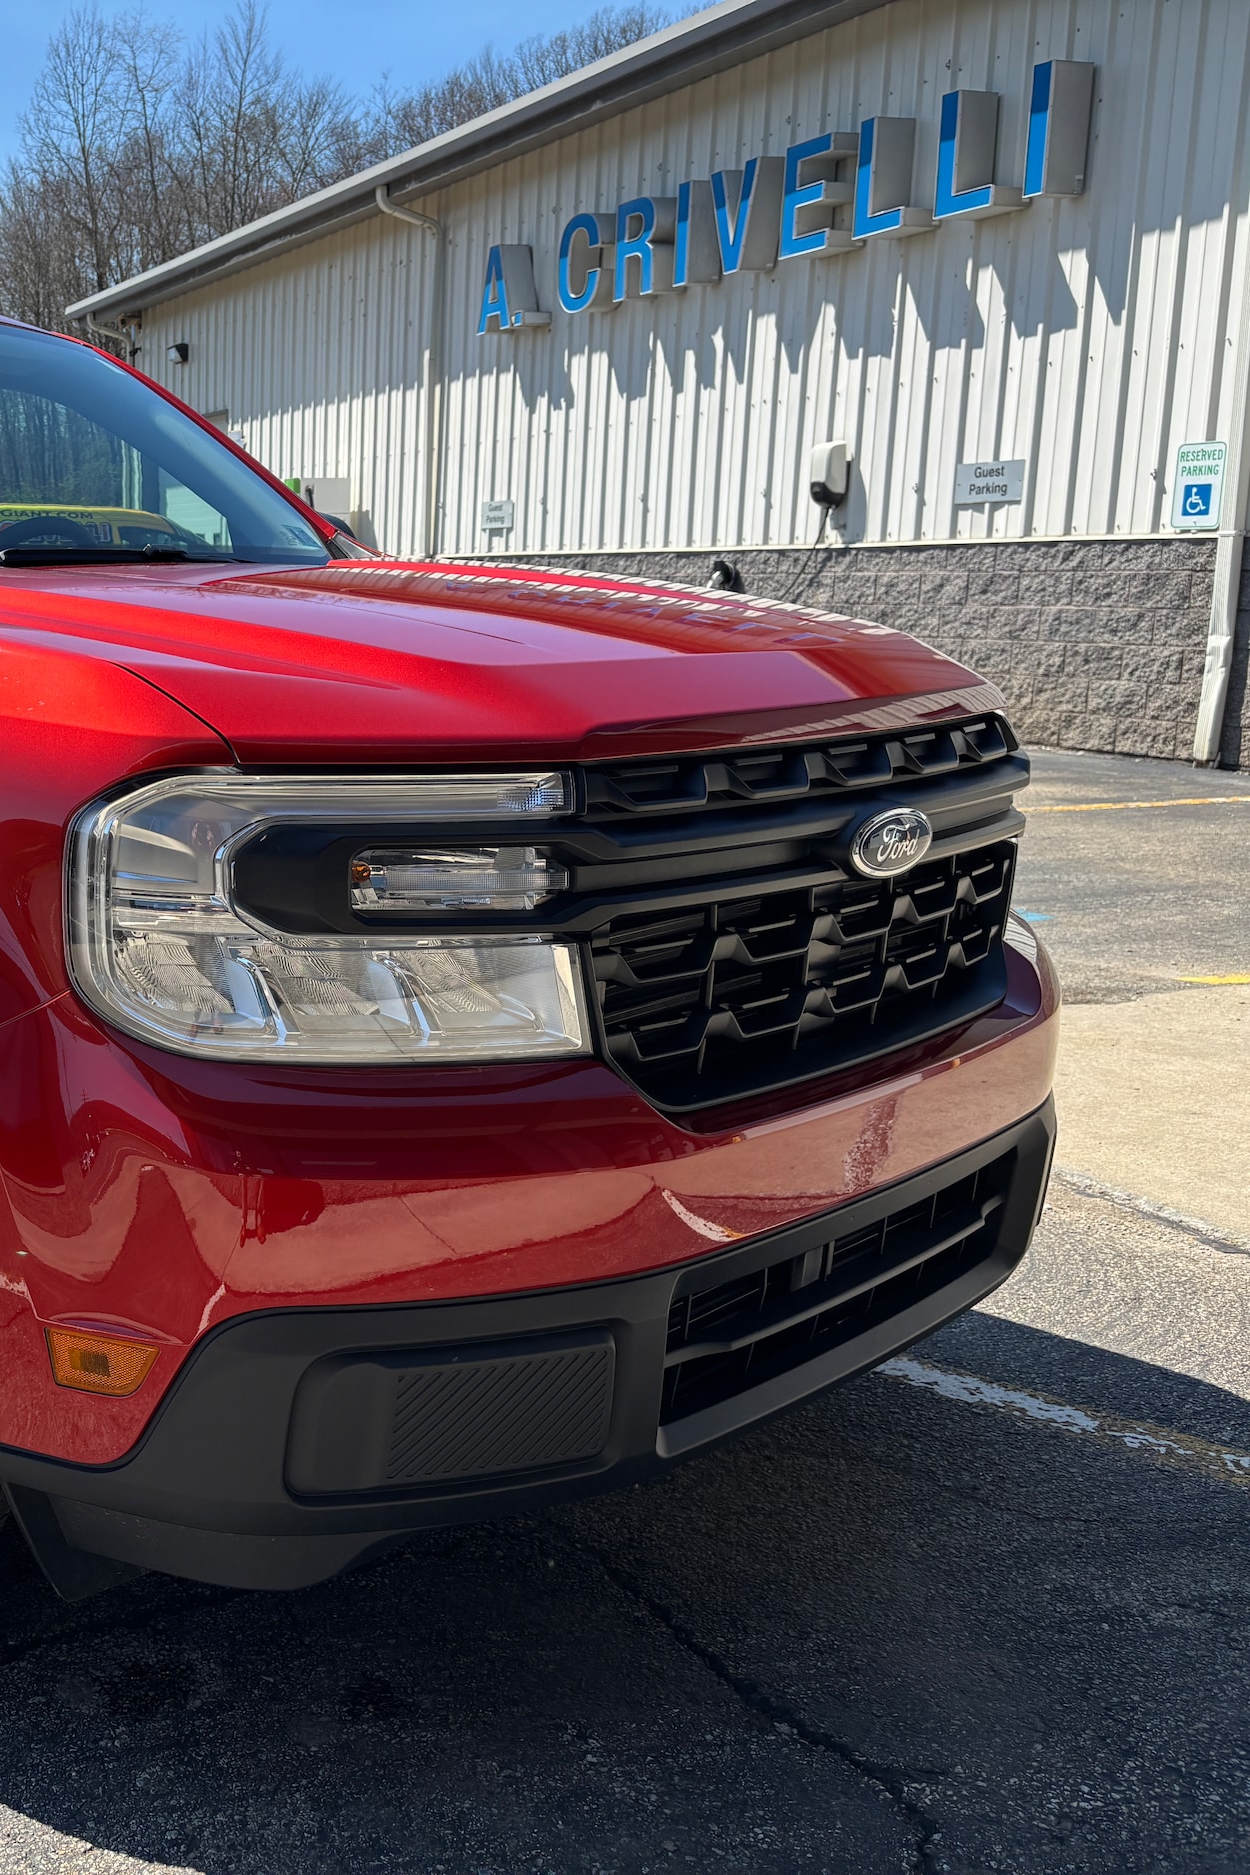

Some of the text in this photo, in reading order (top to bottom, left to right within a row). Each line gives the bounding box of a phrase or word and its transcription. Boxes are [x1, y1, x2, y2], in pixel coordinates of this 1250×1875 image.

[557, 60, 1076, 314] CRIVELLI
[1180, 449, 1223, 463] RESERVED
[974, 465, 1005, 479] Guest
[1181, 464, 1219, 477] PARKING
[968, 482, 1008, 497] Parking
[876, 822, 921, 863] Ford
